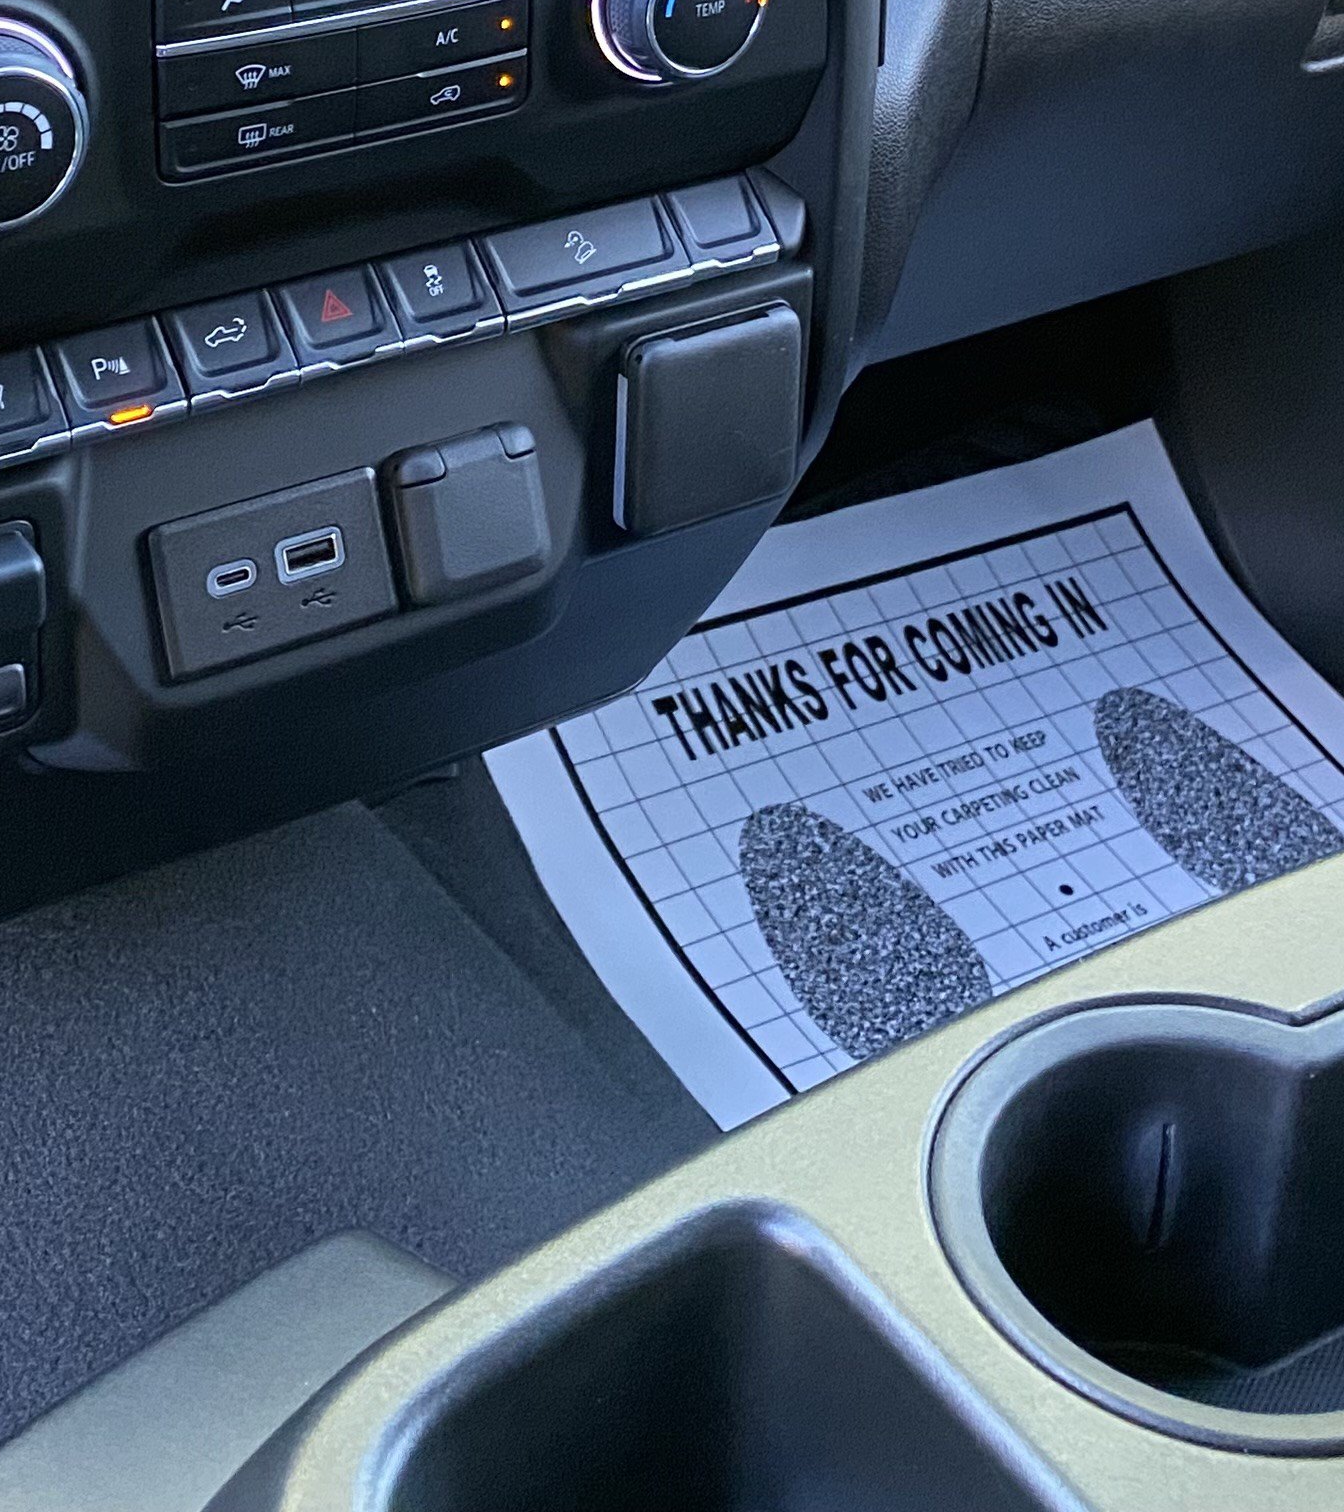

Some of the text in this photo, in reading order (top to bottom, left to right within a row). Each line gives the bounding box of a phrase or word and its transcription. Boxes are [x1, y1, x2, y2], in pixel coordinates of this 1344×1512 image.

[695, 0, 726, 18] TEMP
[436, 28, 459, 47] A/C
[269, 65, 291, 78] MAX
[269, 124, 294, 137] REAR
[652, 577, 1108, 760] THANKS FOR COMING IN
[863, 730, 1047, 804] WE HAVE TRIED TO KEEP
[890, 767, 1080, 843] YOUR CARPETING CLEAN
[932, 805, 1105, 878] WITH THIS PAPER MAT
[1043, 902, 1148, 952] A customer is
